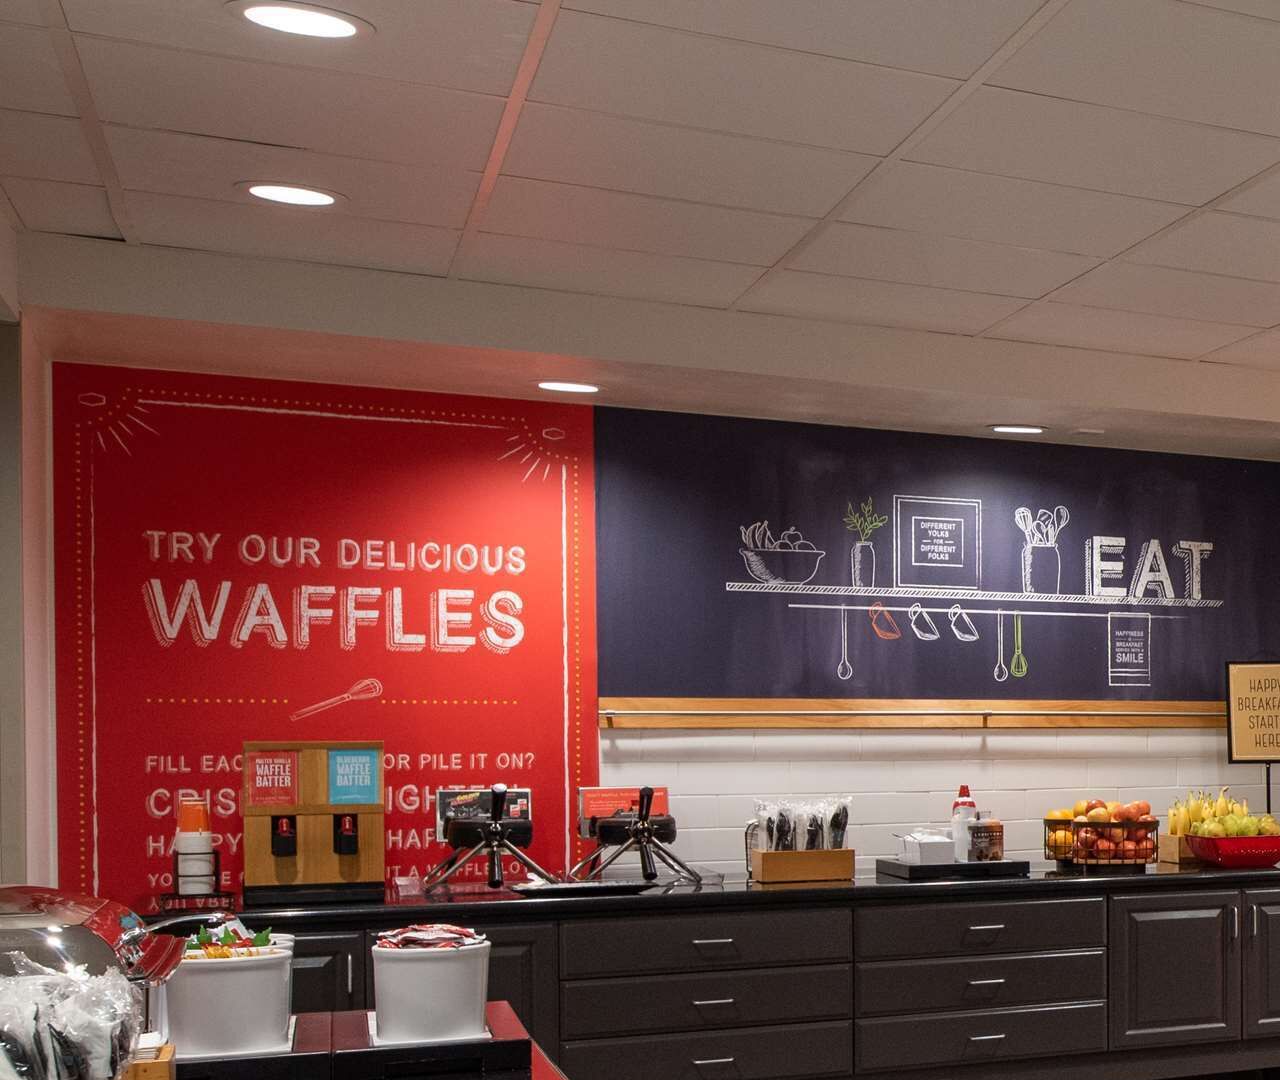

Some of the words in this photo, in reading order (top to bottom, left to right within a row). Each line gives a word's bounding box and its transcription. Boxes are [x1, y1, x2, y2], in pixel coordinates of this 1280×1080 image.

[920, 521, 957, 531] DIFFERENT
[927, 530, 949, 538] YOLKS
[144, 529, 222, 562] TRY
[239, 533, 321, 566] OUR
[337, 538, 527, 576] DELICIOUS
[920, 544, 957, 553] DIFFERENT
[927, 552, 949, 560] FOLKS
[1085, 535, 1214, 601] EAT
[142, 577, 526, 655] WAFFLES
[1115, 653, 1144, 663] SMILE
[1254, 733, 1280, 748] HERE
[145, 755, 192, 773] FILL
[200, 754, 243, 772] EAC
[384, 753, 411, 770] OR
[418, 753, 462, 770] PILE
[469, 753, 489, 770] IT
[495, 752, 536, 770] ON?
[255, 764, 291, 776] WAFFLE
[336, 763, 371, 775] WAFFLE
[255, 776, 291, 787] BATTER
[336, 775, 371, 786] BATTER
